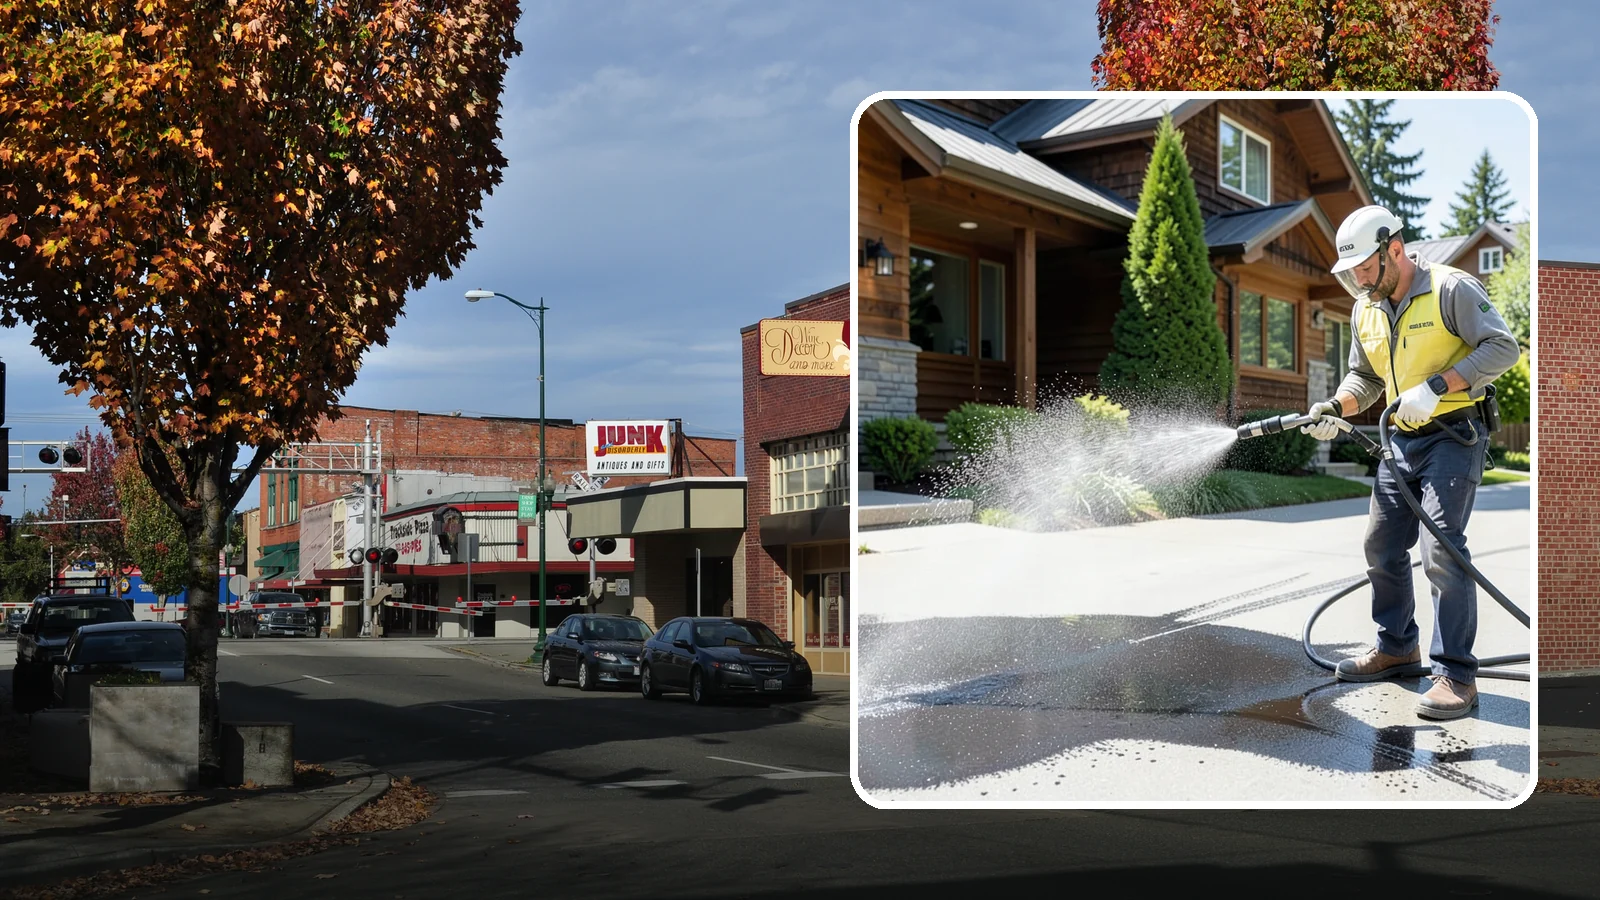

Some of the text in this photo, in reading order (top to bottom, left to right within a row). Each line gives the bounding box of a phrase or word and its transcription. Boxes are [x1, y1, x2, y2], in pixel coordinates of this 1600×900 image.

[595, 425, 665, 457] JUNK
[607, 446, 646, 454] DISORDERLY
[596, 460, 666, 470] ANTIQUES AND GIFTS
[414, 519, 429, 534] Pizza
